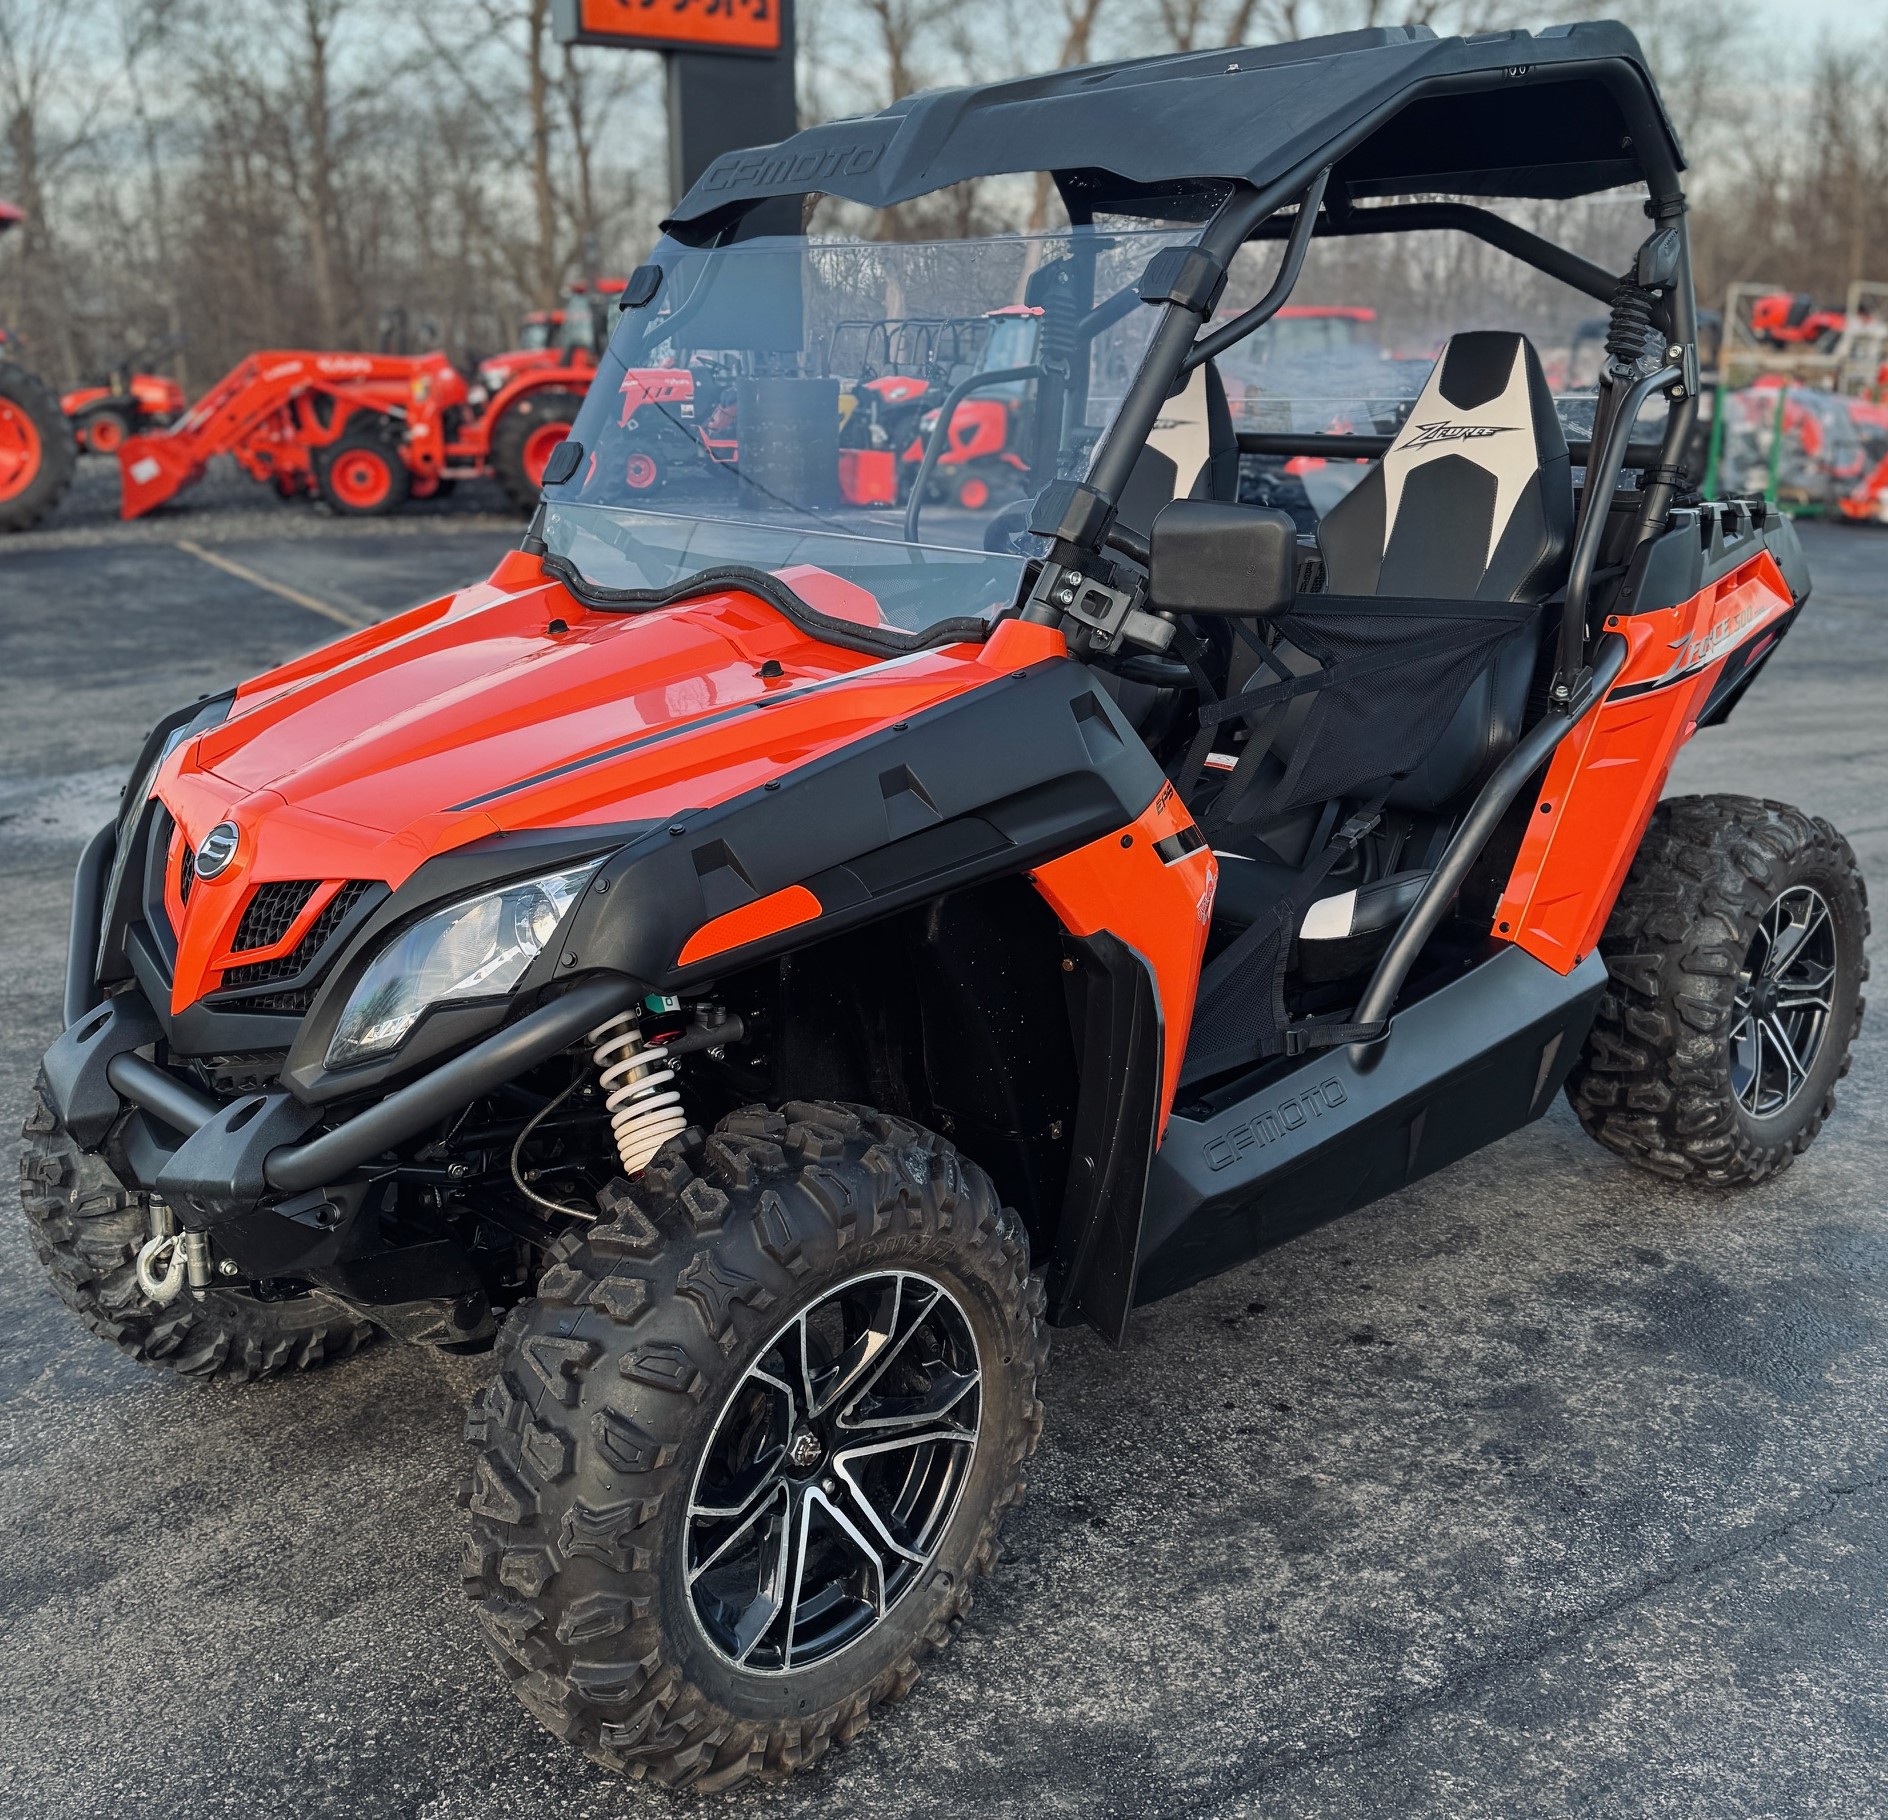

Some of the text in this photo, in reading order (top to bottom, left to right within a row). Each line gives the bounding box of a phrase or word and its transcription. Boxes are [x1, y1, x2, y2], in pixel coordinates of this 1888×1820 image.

[702, 144, 885, 191] CFMOTO
[1156, 782, 1174, 816] EPS
[1203, 1075, 1348, 1172] CFMOTO
